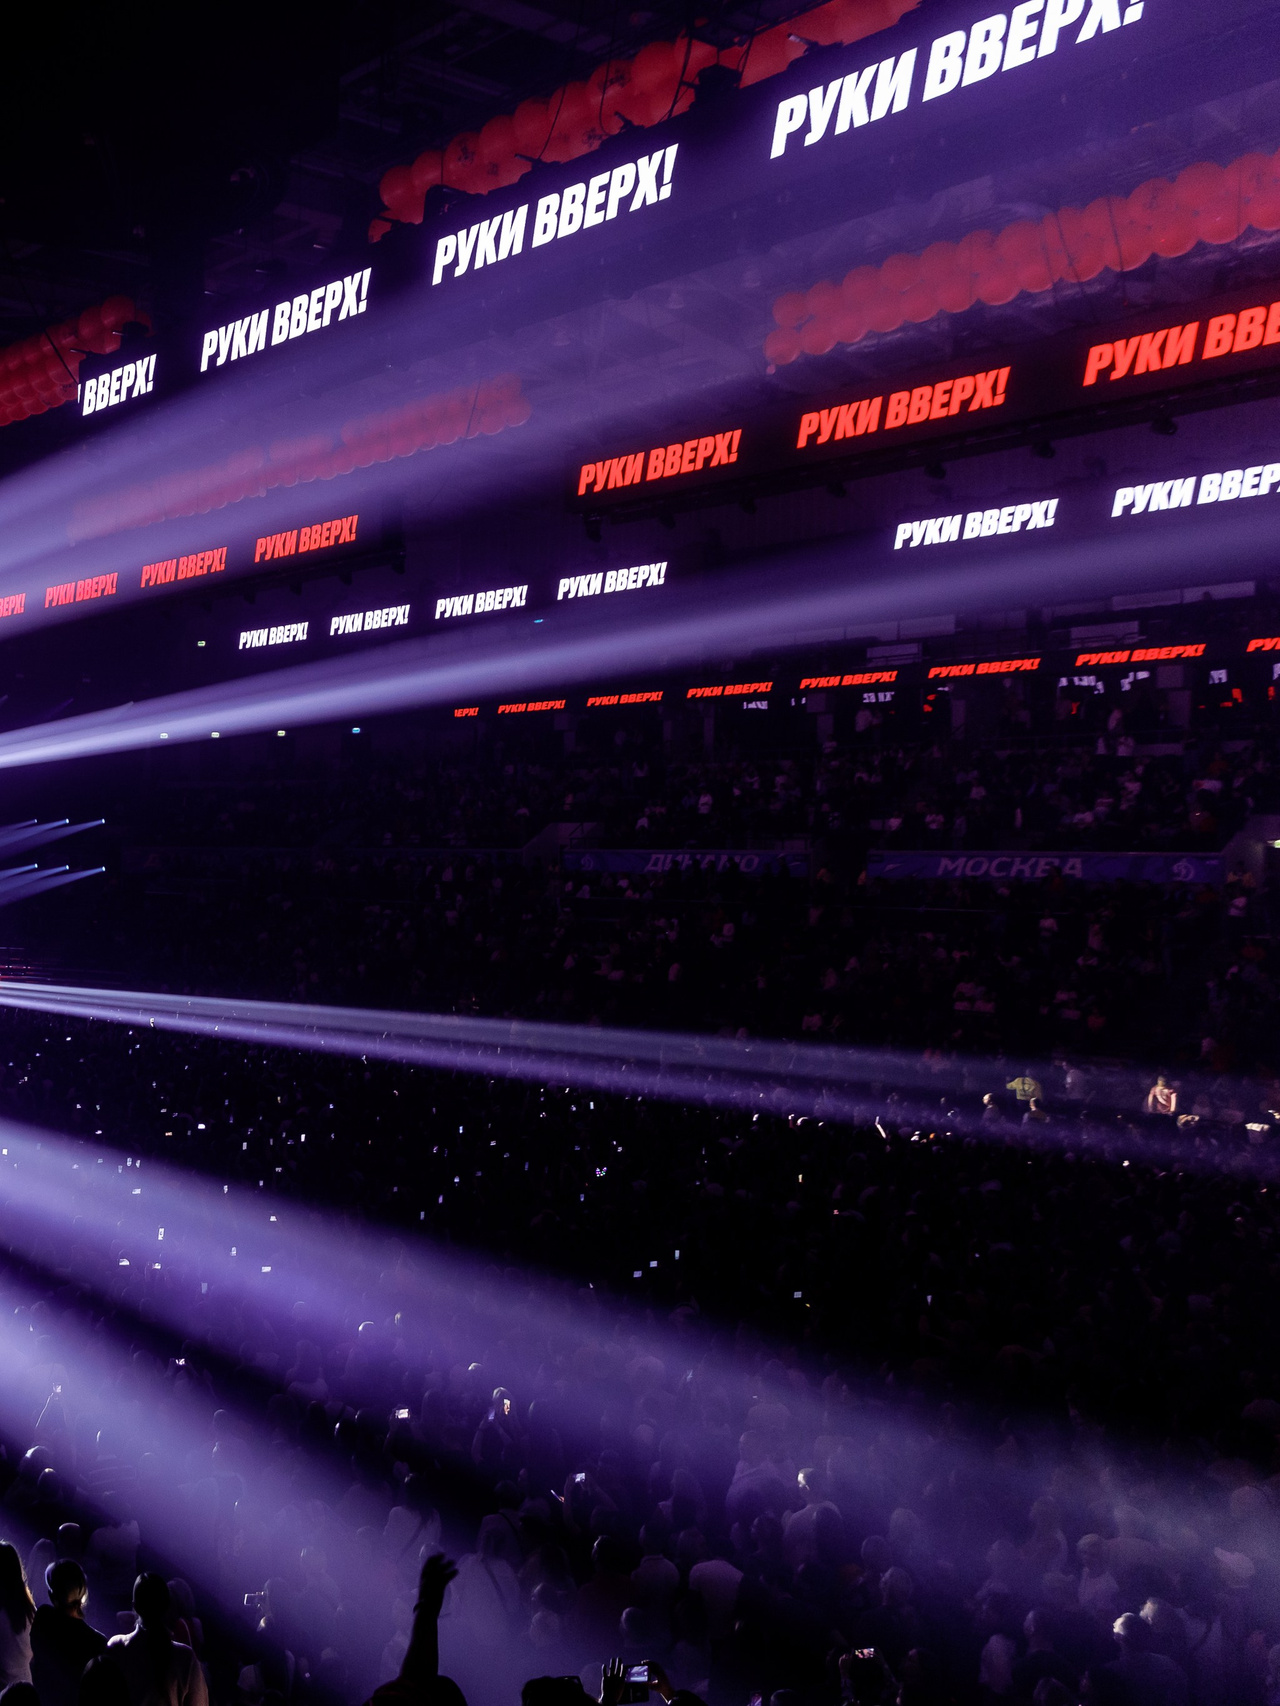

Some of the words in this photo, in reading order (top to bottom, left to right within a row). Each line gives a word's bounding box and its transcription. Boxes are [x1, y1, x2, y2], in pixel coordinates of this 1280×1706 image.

[769, 48, 918, 160] РУКИ
[431, 204, 529, 286] РУКИ
[532, 143, 679, 249] ВВЕРХ!
[200, 309, 270, 373] РУКИ
[270, 268, 372, 346] ВВЕРХ!
[1082, 321, 1200, 387] РУКИ
[82, 353, 157, 417] ВВЕРХ!
[796, 395, 883, 449] РУКИ
[884, 366, 1011, 430] ВВЕРХ!
[577, 451, 645, 496] РУКИ
[645, 429, 742, 481] ВВЕРХ!
[1111, 476, 1197, 518] РУКИ
[1197, 463, 1280, 505] ВВЕР
[255, 530, 298, 563] РУКИ
[298, 515, 359, 553] ВВЕРХ!
[893, 514, 963, 550] РУКИ
[963, 498, 1059, 540] ВВЕРХ!
[140, 558, 177, 588] РУКИ
[177, 547, 227, 580] ВВЕРХ!
[557, 572, 604, 601] РУКИ
[604, 561, 668, 594] ВВЕРХ!
[44, 581, 76, 608] РУКИ
[76, 572, 118, 602] ВВЕРХ!
[434, 593, 475, 620] РУКИ
[475, 584, 528, 614] ВВЕРХ!
[239, 628, 269, 650] РУКИ
[268, 621, 309, 646] ВВЕРХ!
[329, 612, 364, 636] РУКИ
[363, 604, 410, 631] ВВЕРХ!
[927, 663, 976, 679] РУКИ
[975, 658, 1041, 675] ВВЕРХ!
[1075, 650, 1131, 666] РУКИ
[1130, 643, 1206, 662] ВВЕРХ!
[587, 695, 620, 707] РУКИ
[619, 691, 664, 704] ВВЕРХ!
[687, 685, 724, 699] РУКИ
[723, 682, 773, 696] ВВЕРХ!
[800, 675, 842, 689] РУКИ
[841, 671, 898, 686] ВВЕРХ!
[498, 703, 527, 714] РУКИ
[526, 700, 566, 712] ВВЕРХ!
[937, 856, 1083, 878] МОСКВА
